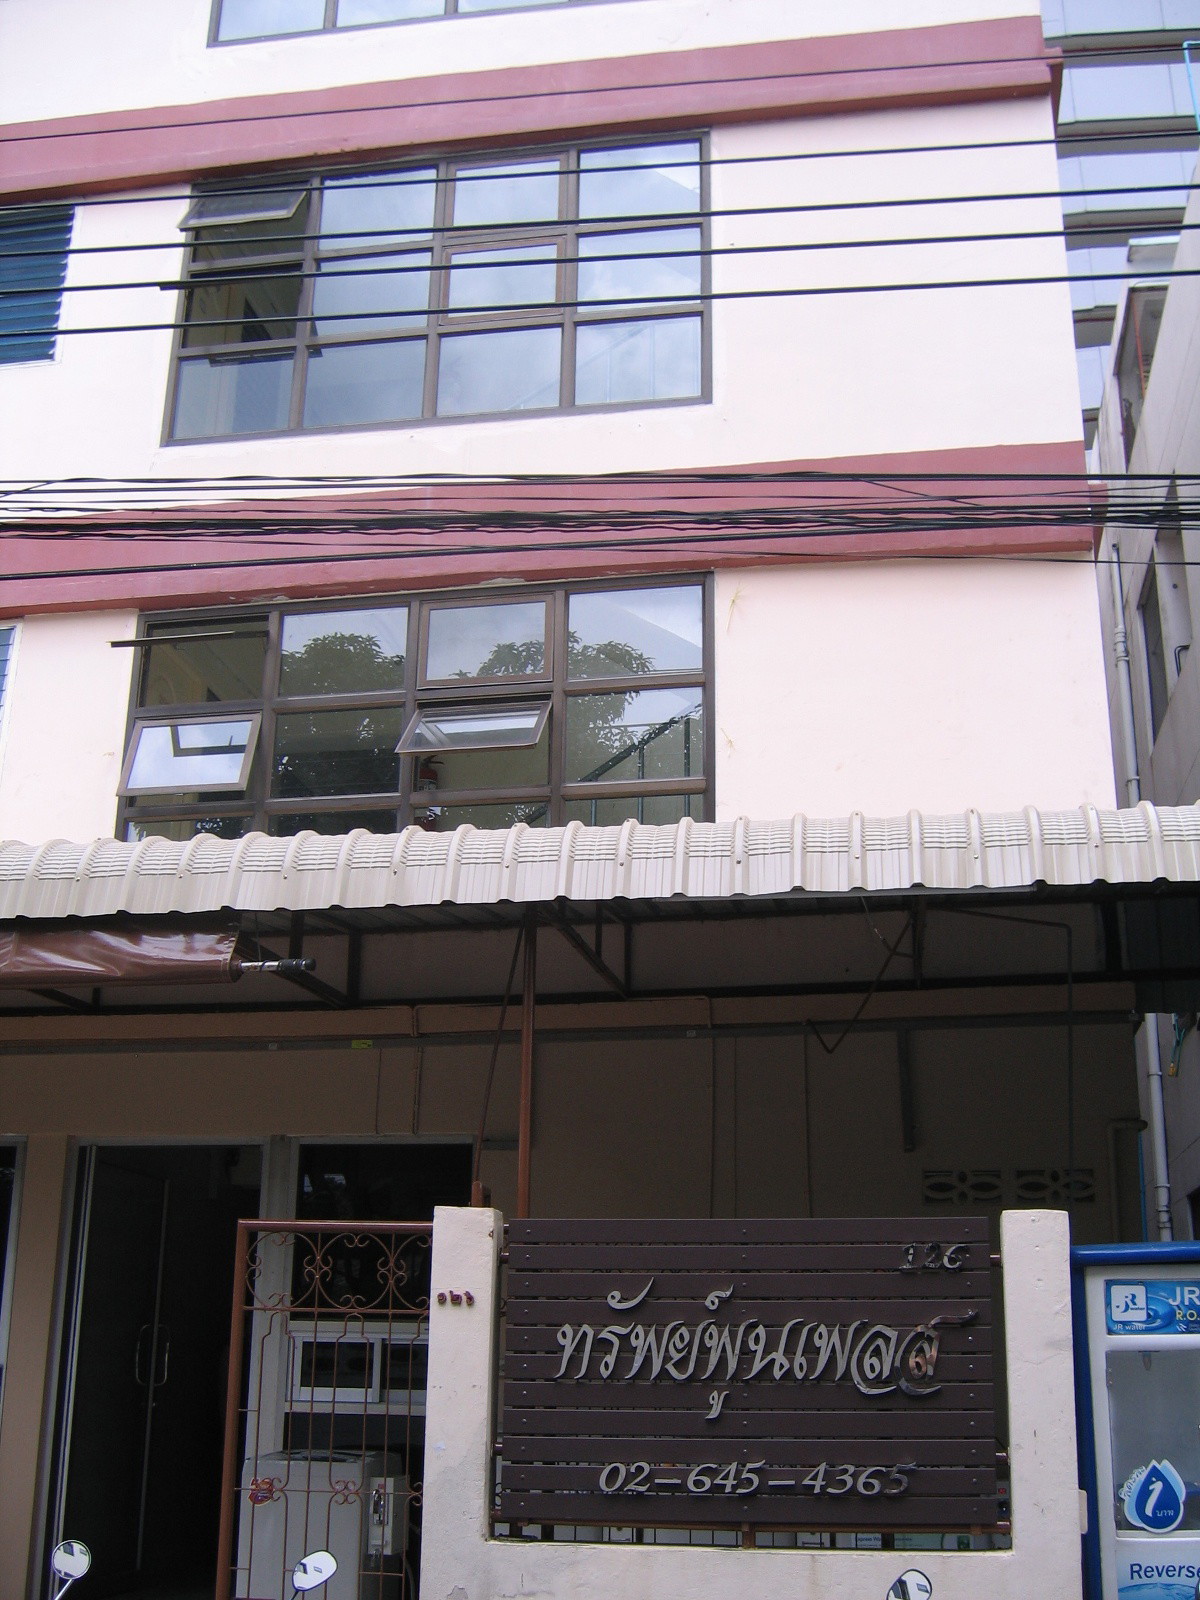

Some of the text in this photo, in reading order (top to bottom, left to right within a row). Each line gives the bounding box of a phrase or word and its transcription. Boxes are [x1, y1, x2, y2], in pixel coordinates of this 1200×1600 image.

[899, 1242, 970, 1269] 126
[554, 1276, 979, 1420] ทรัพย์พูนเพลส
